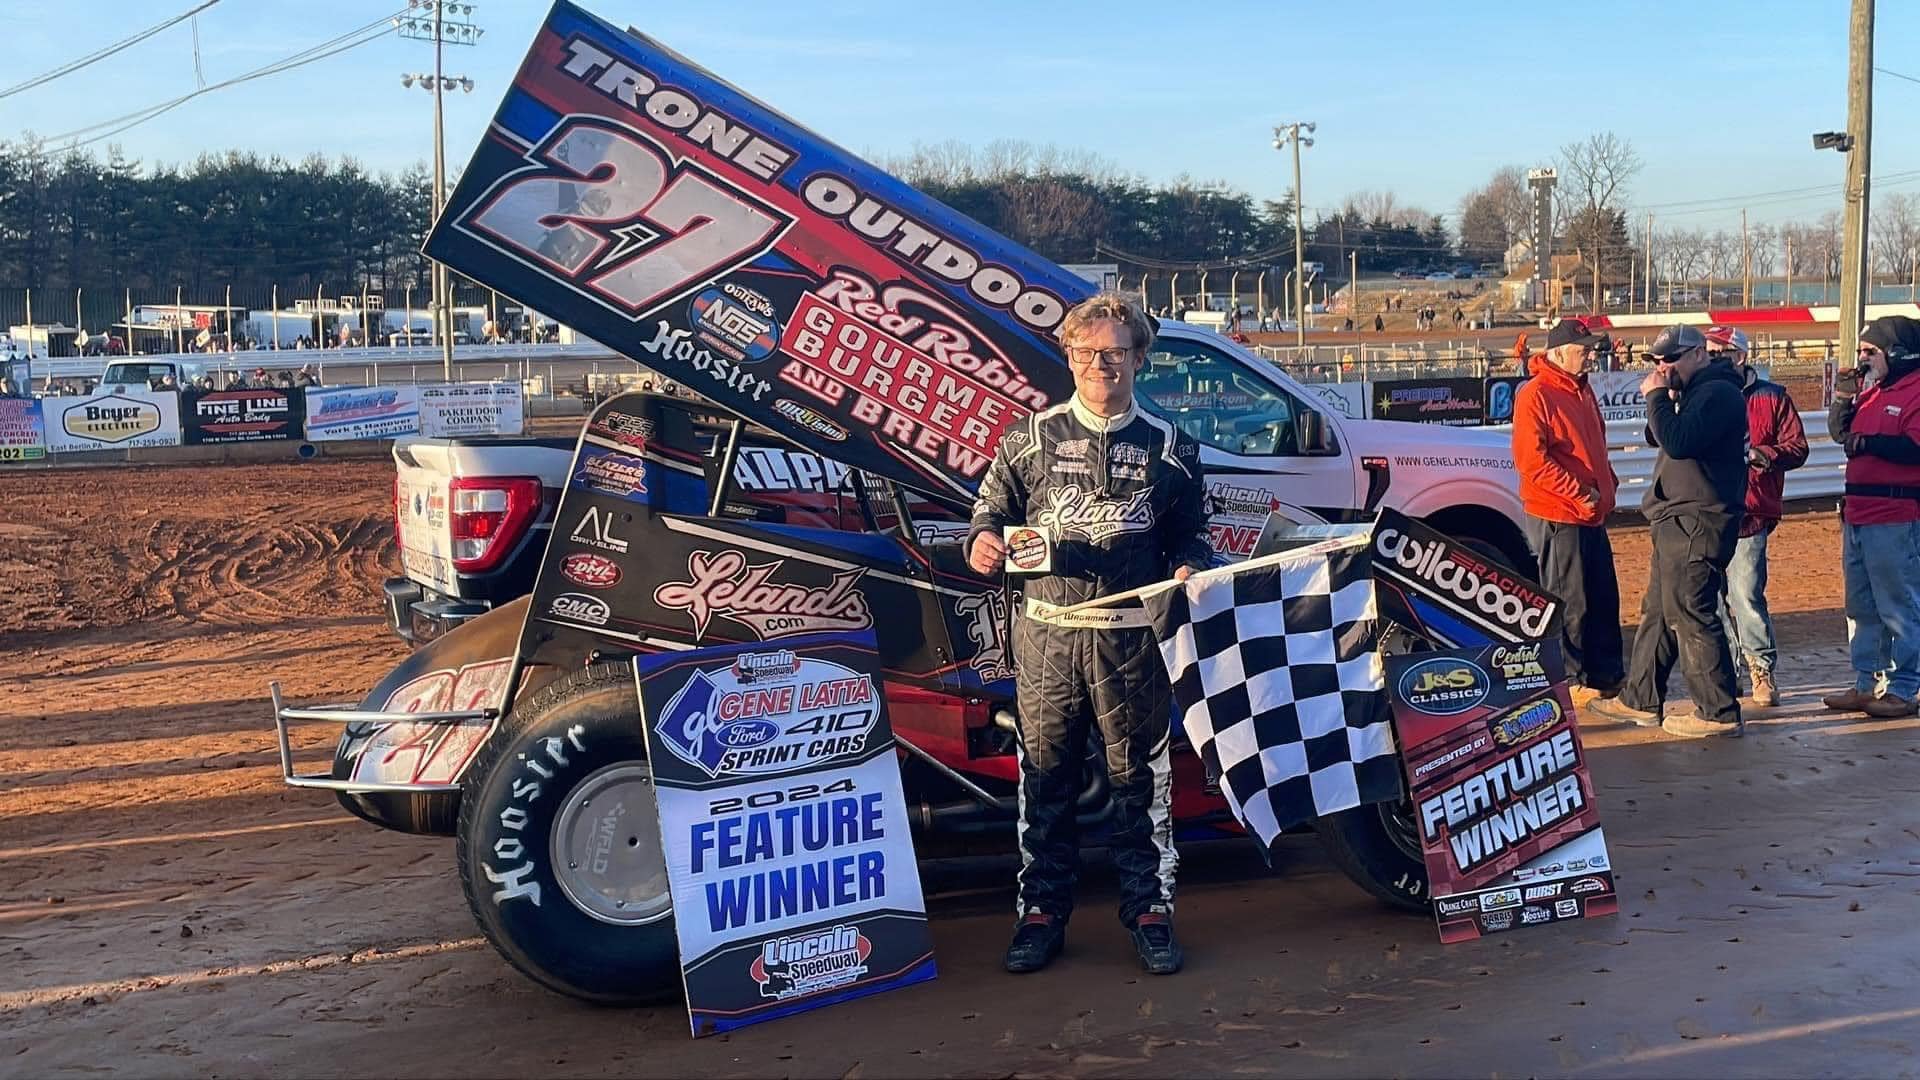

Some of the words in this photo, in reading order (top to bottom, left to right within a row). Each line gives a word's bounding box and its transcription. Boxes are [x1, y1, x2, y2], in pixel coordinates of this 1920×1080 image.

[563, 39, 791, 180] TRONE
[472, 122, 782, 311] 27
[724, 283, 775, 317] OUTLAWS
[702, 298, 765, 344] NOS
[816, 271, 923, 337] Red
[884, 286, 1049, 408] Robin
[639, 319, 772, 402] Hoosier
[782, 360, 845, 402] AND
[85, 406, 141, 422] Boyer
[196, 399, 240, 416] FINE
[246, 397, 289, 412] LINE
[214, 414, 241, 424] Auto
[244, 412, 271, 423] Body
[87, 421, 142, 432] ELECTRIC
[852, 395, 989, 477] BREW
[68, 442, 91, 451] Berlin
[1212, 482, 1273, 504] Lincoln
[1226, 500, 1272, 515] Speedway
[570, 535, 627, 554] DRIVELINE
[575, 562, 611, 576] DMI
[1376, 528, 1556, 638] wilwood
[1472, 561, 1549, 610] RACING
[552, 597, 604, 616] CMC
[655, 550, 873, 641] Lelands
[763, 616, 805, 632] .com
[739, 651, 794, 668] Lincoln
[754, 664, 794, 678] Speedway
[1491, 642, 1541, 669] Central
[1502, 661, 1545, 678] PA
[1410, 688, 1484, 704] CLASSICS
[1413, 668, 1475, 692] J&S
[719, 686, 795, 721] GENE
[800, 677, 871, 710] LATTA
[727, 724, 766, 745] Ford
[785, 710, 873, 736] 410
[720, 742, 805, 771] SPRINT
[808, 733, 865, 758] CARS
[1415, 743, 1472, 777] PRESENTED
[1474, 736, 1487, 749] BY
[709, 777, 856, 816] 2024
[1420, 730, 1577, 839] FEATURE
[480, 724, 585, 907] Hoosier
[691, 792, 885, 874] FEATURE
[1449, 774, 1583, 870] WINNER
[705, 850, 886, 933] WINNER
[764, 926, 858, 966] Lincoln
[790, 951, 859, 980] Speedway
